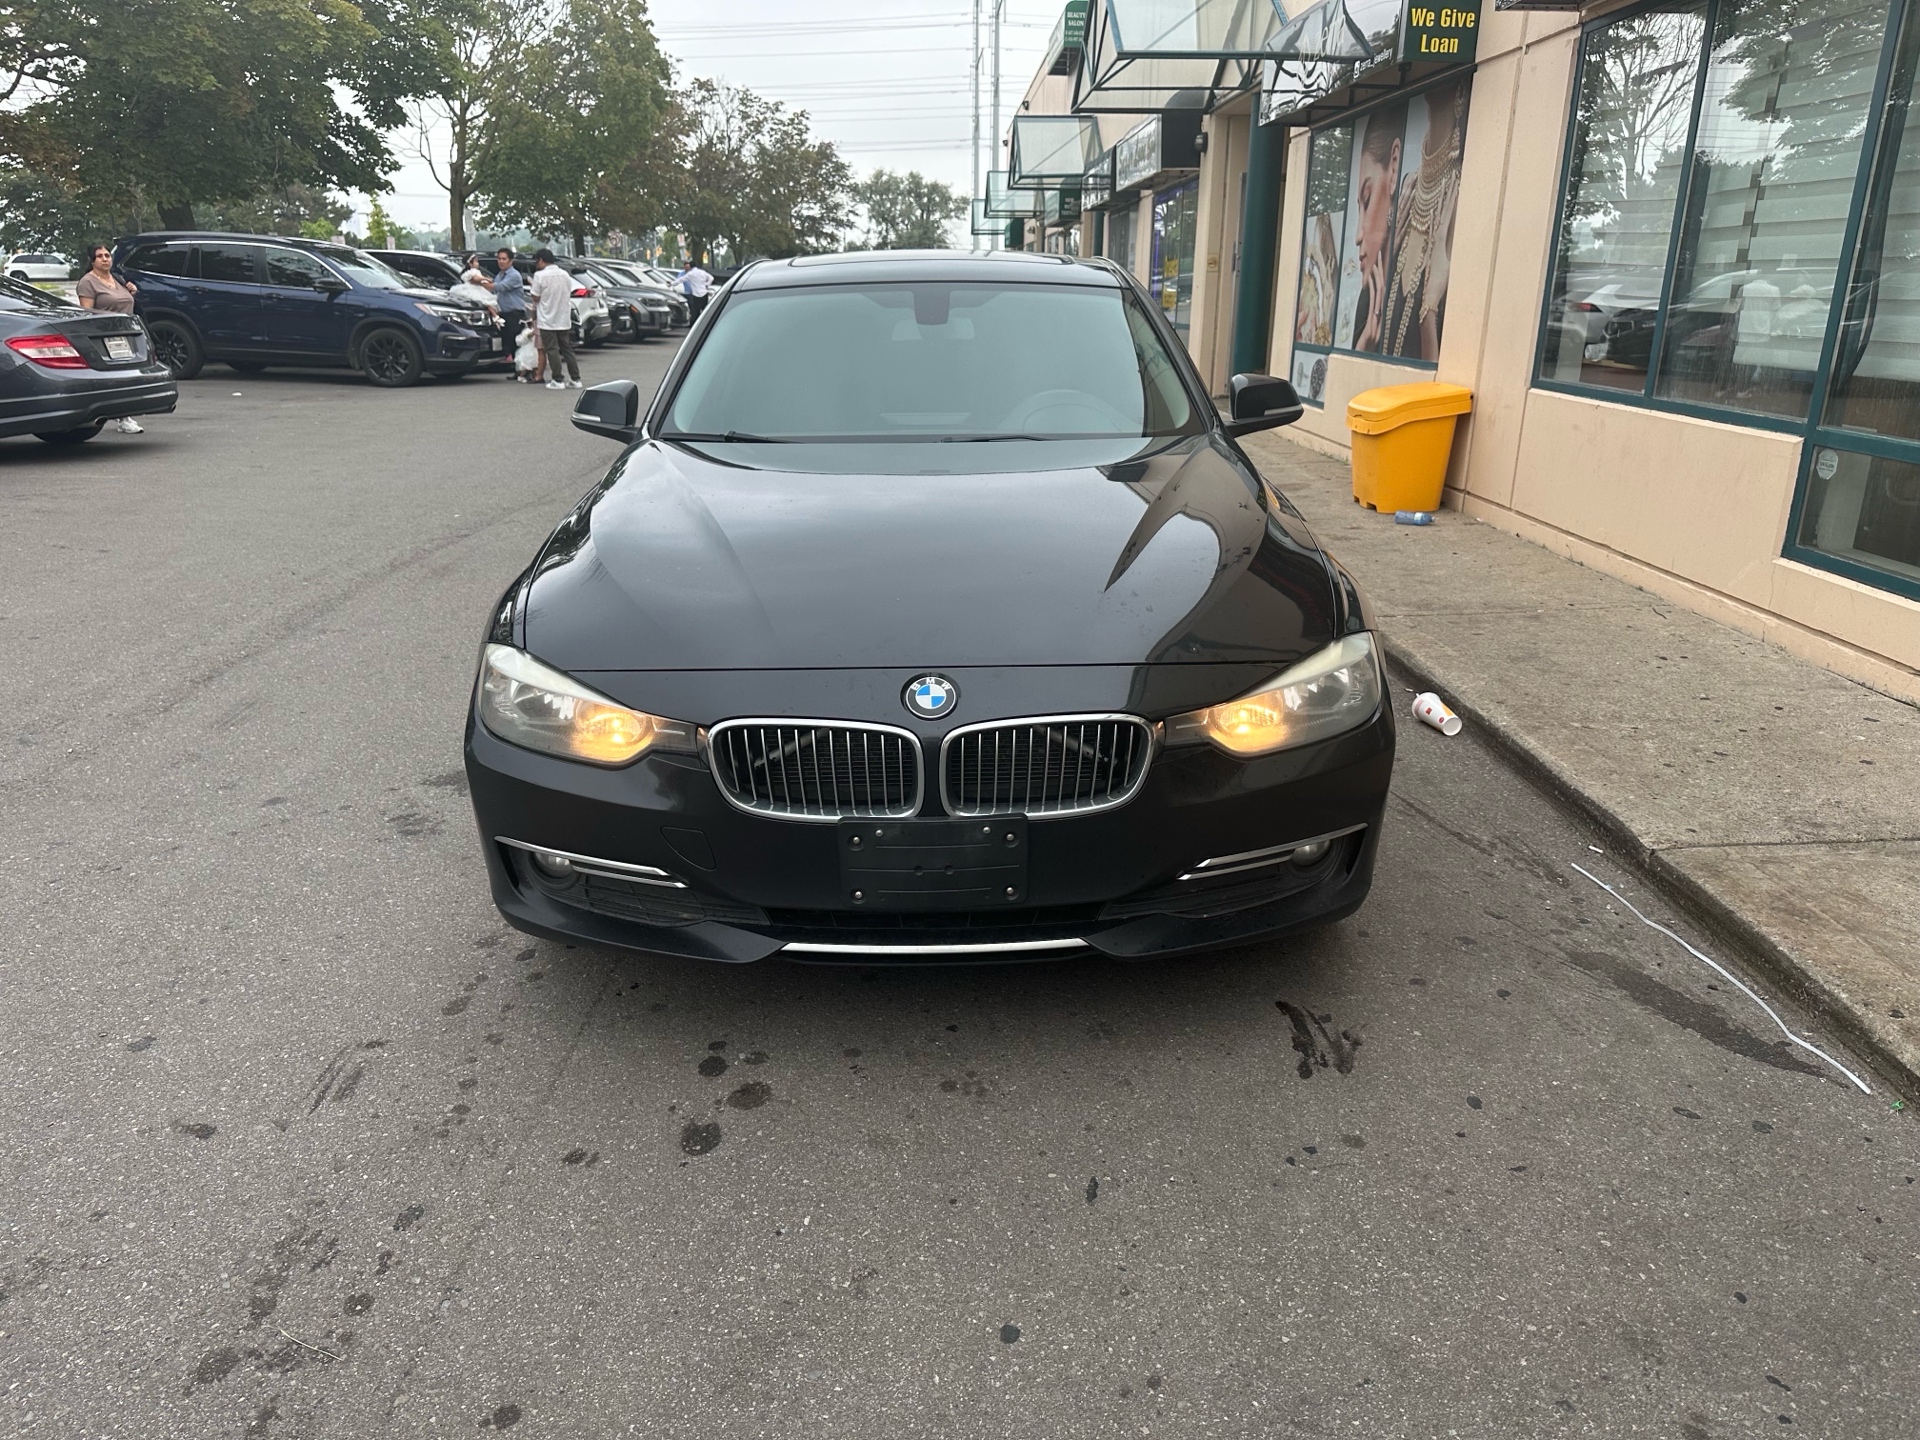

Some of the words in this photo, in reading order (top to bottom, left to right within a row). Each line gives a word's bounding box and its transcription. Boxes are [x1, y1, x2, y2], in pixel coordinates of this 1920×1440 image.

[1067, 19, 1085, 27] SALON
[1411, 8, 1435, 27] We
[1440, 8, 1475, 28] Give
[1420, 33, 1459, 53] Loan
[910, 678, 951, 691] BMW
